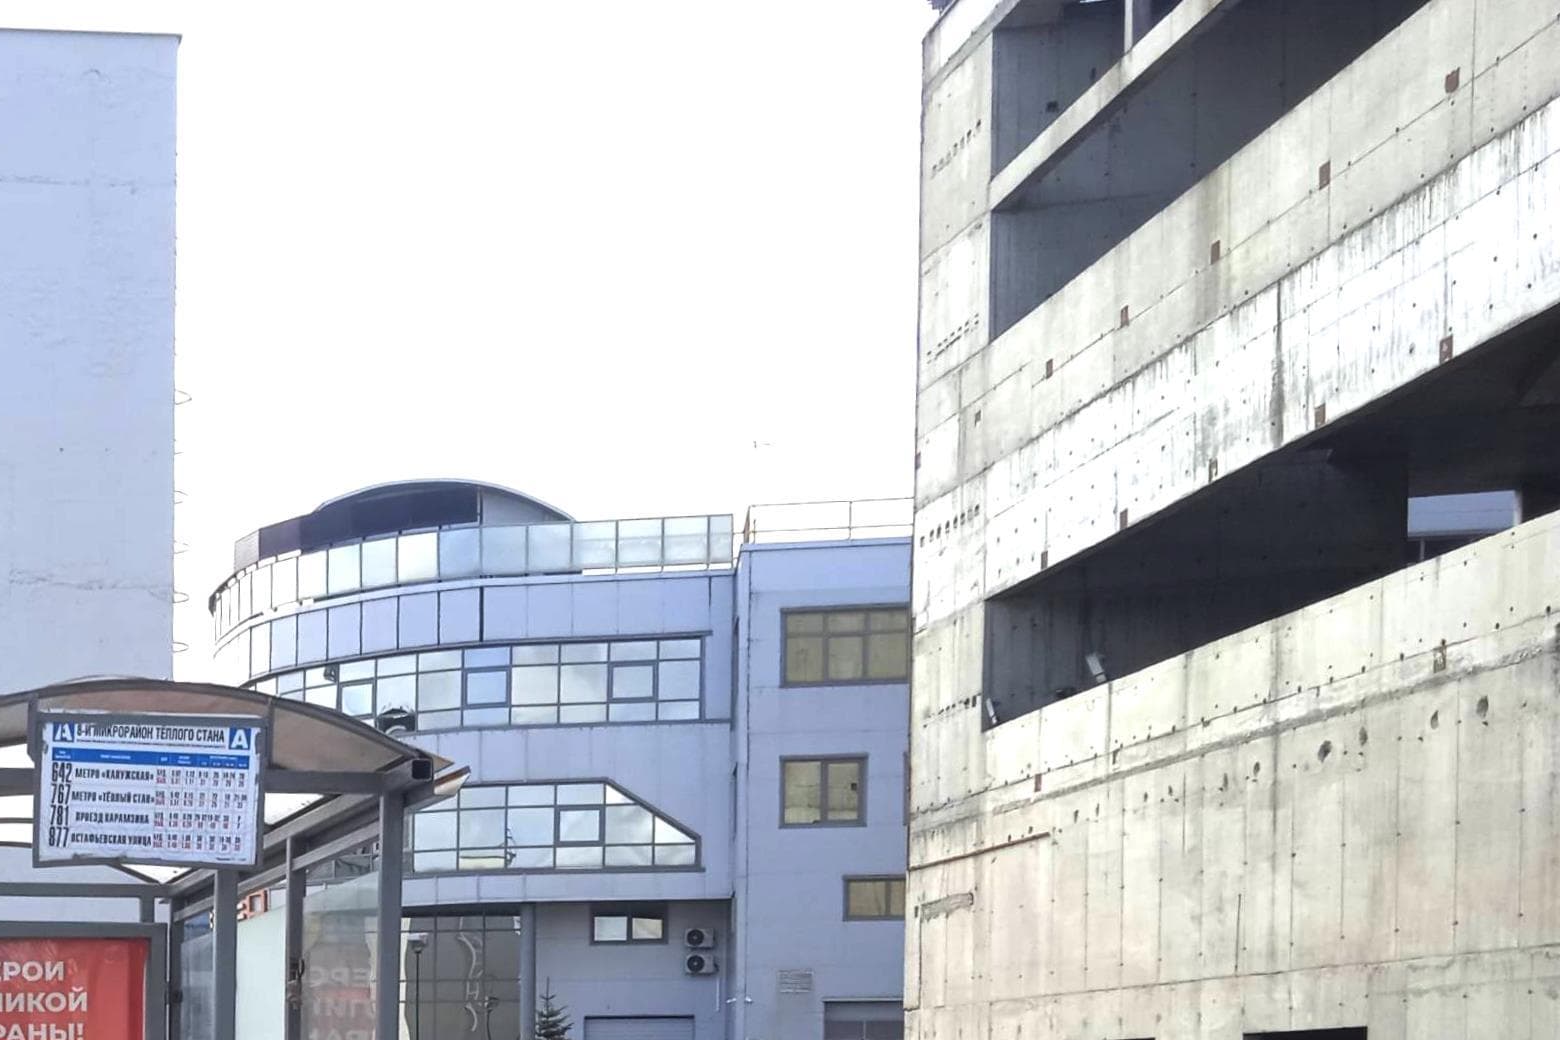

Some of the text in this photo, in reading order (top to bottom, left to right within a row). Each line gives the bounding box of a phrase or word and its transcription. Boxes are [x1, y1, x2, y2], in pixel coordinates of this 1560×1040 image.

[156, 727, 195, 741] ТЕПЛОГО
[196, 729, 225, 743] СТАНА
[51, 762, 73, 783] 642
[75, 767, 100, 779] МЕТРО
[50, 783, 71, 805] 767
[71, 790, 97, 802] МЕТРО
[50, 804, 69, 826] 781
[75, 811, 103, 824] ПРОЕЗД
[48, 826, 69, 848] 877
[127, 835, 152, 847] УЛИЦА
